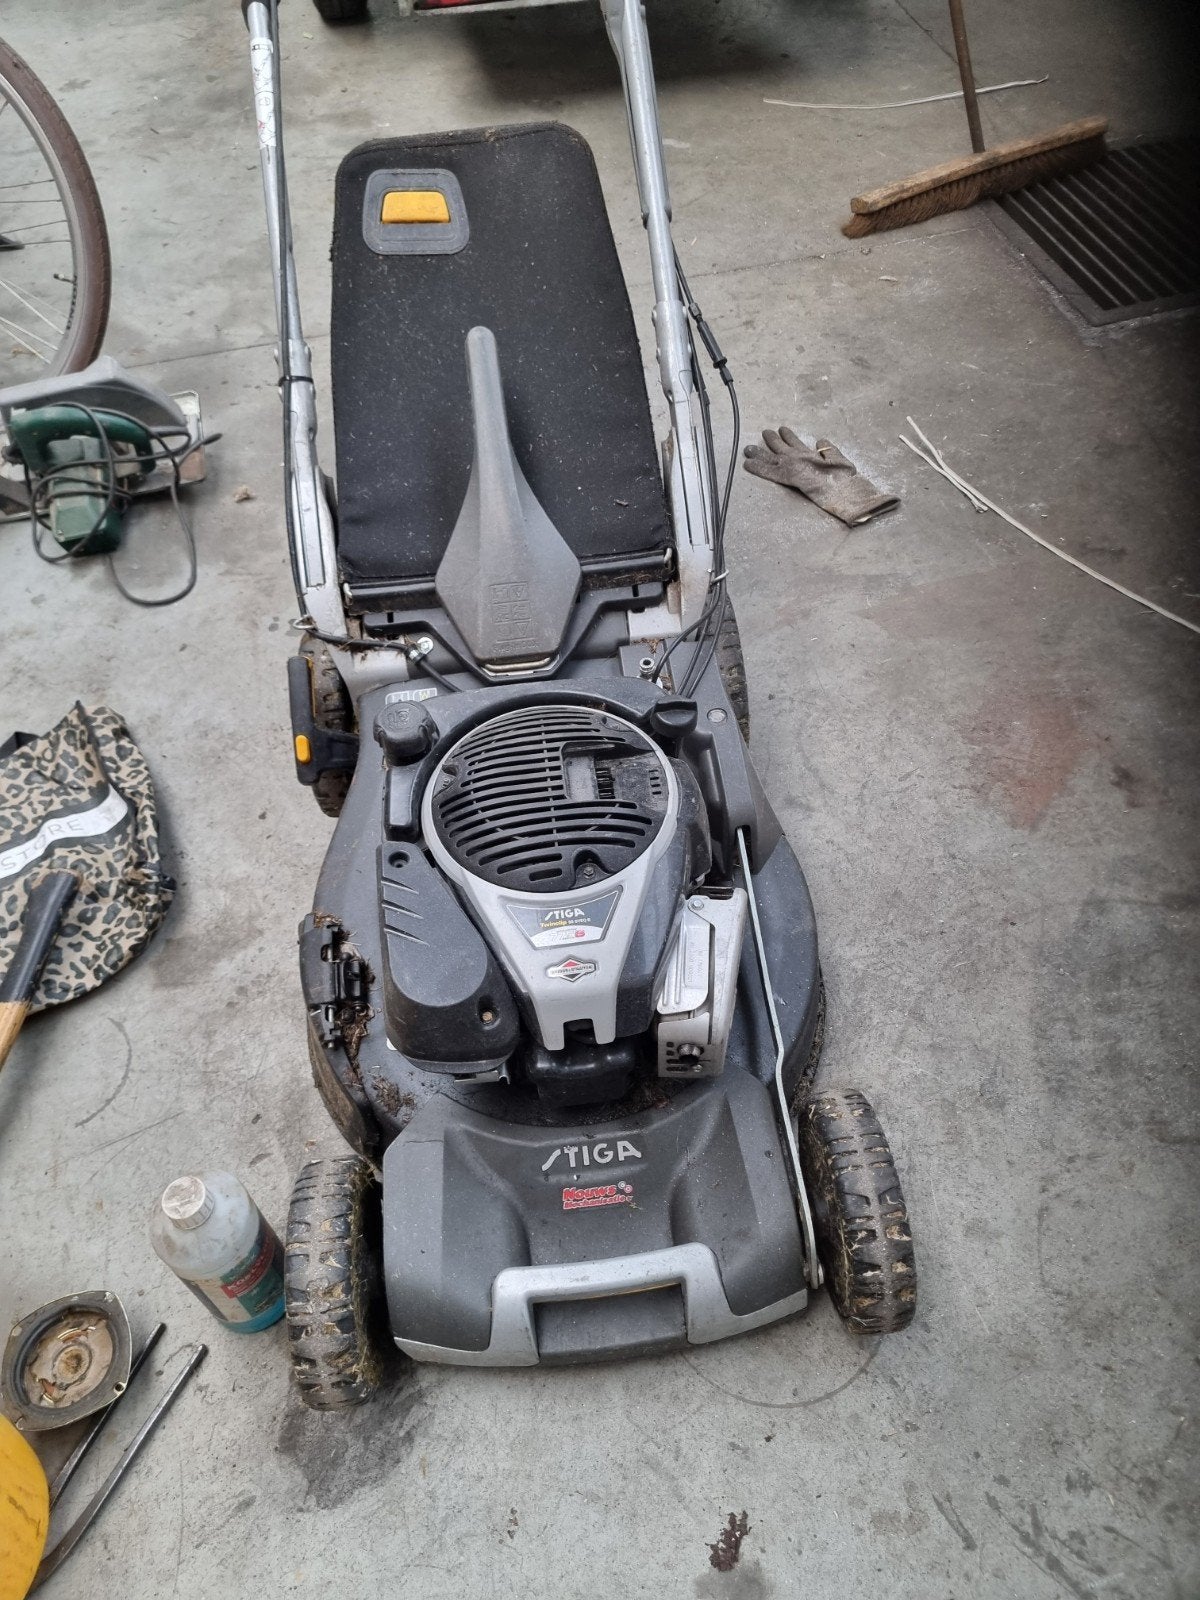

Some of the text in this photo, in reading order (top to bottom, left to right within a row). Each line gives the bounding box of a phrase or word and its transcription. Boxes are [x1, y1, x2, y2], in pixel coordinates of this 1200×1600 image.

[1, 818, 84, 870] STORE
[544, 908, 585, 921] STIGA
[541, 1140, 642, 1172] STIGA
